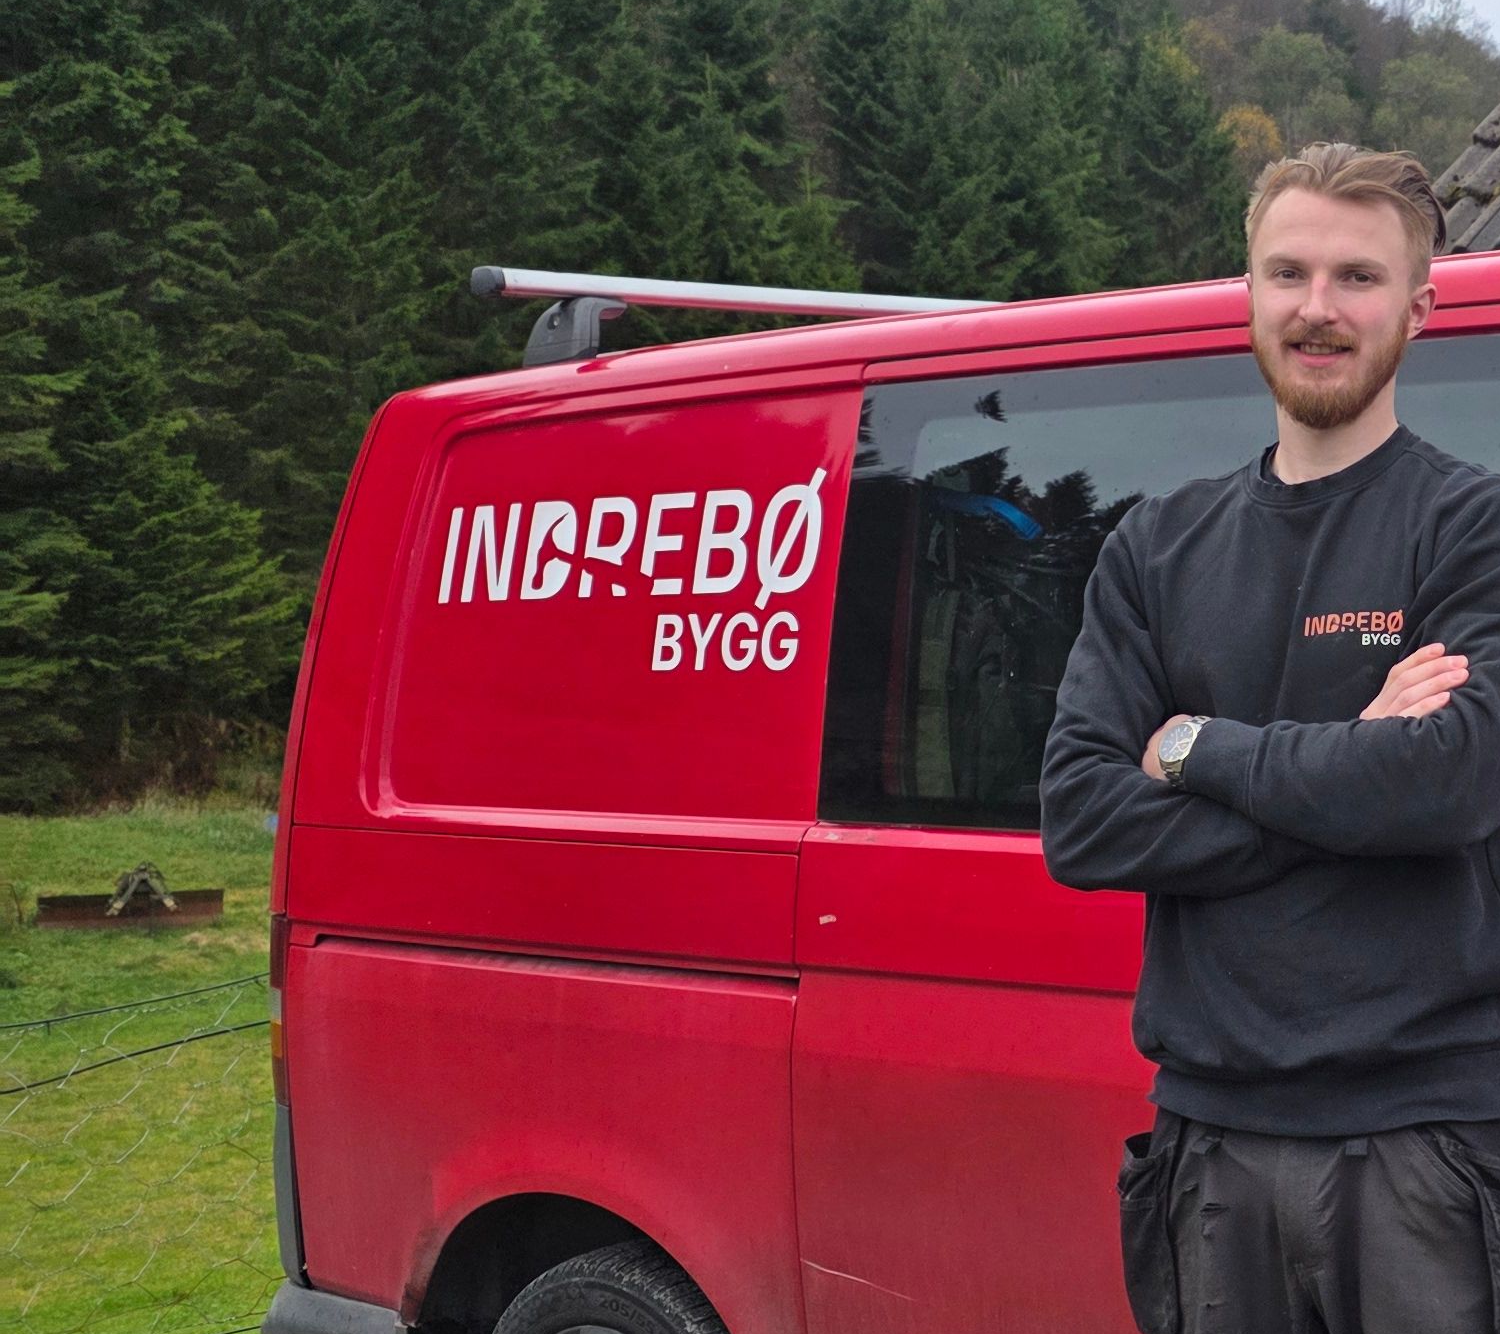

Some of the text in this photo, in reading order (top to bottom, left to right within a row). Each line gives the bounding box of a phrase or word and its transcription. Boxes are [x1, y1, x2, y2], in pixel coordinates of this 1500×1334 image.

[438, 467, 827, 610] INDREBØ
[651, 611, 800, 672] BYGG
[1361, 633, 1402, 646] BYGG
